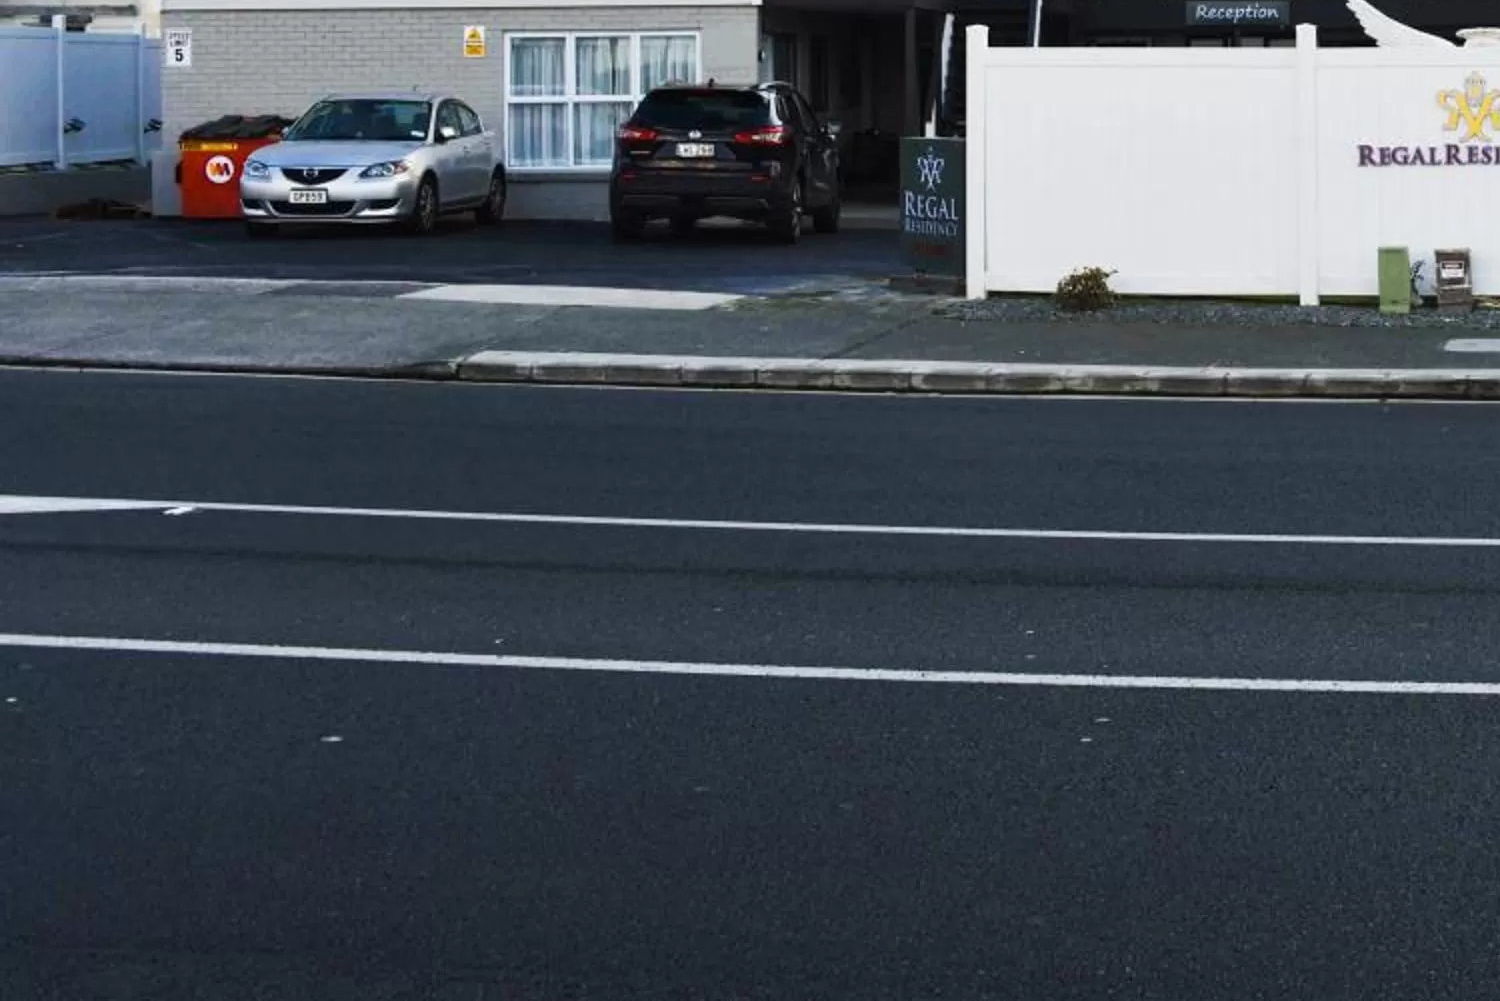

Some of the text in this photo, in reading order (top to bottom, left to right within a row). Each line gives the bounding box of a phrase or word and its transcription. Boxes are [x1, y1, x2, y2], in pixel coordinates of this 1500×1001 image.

[1194, 2, 1279, 23] Reception
[175, 48, 184, 62] 5
[904, 189, 959, 220] REGAL
[904, 217, 959, 236] RESIDENCY
